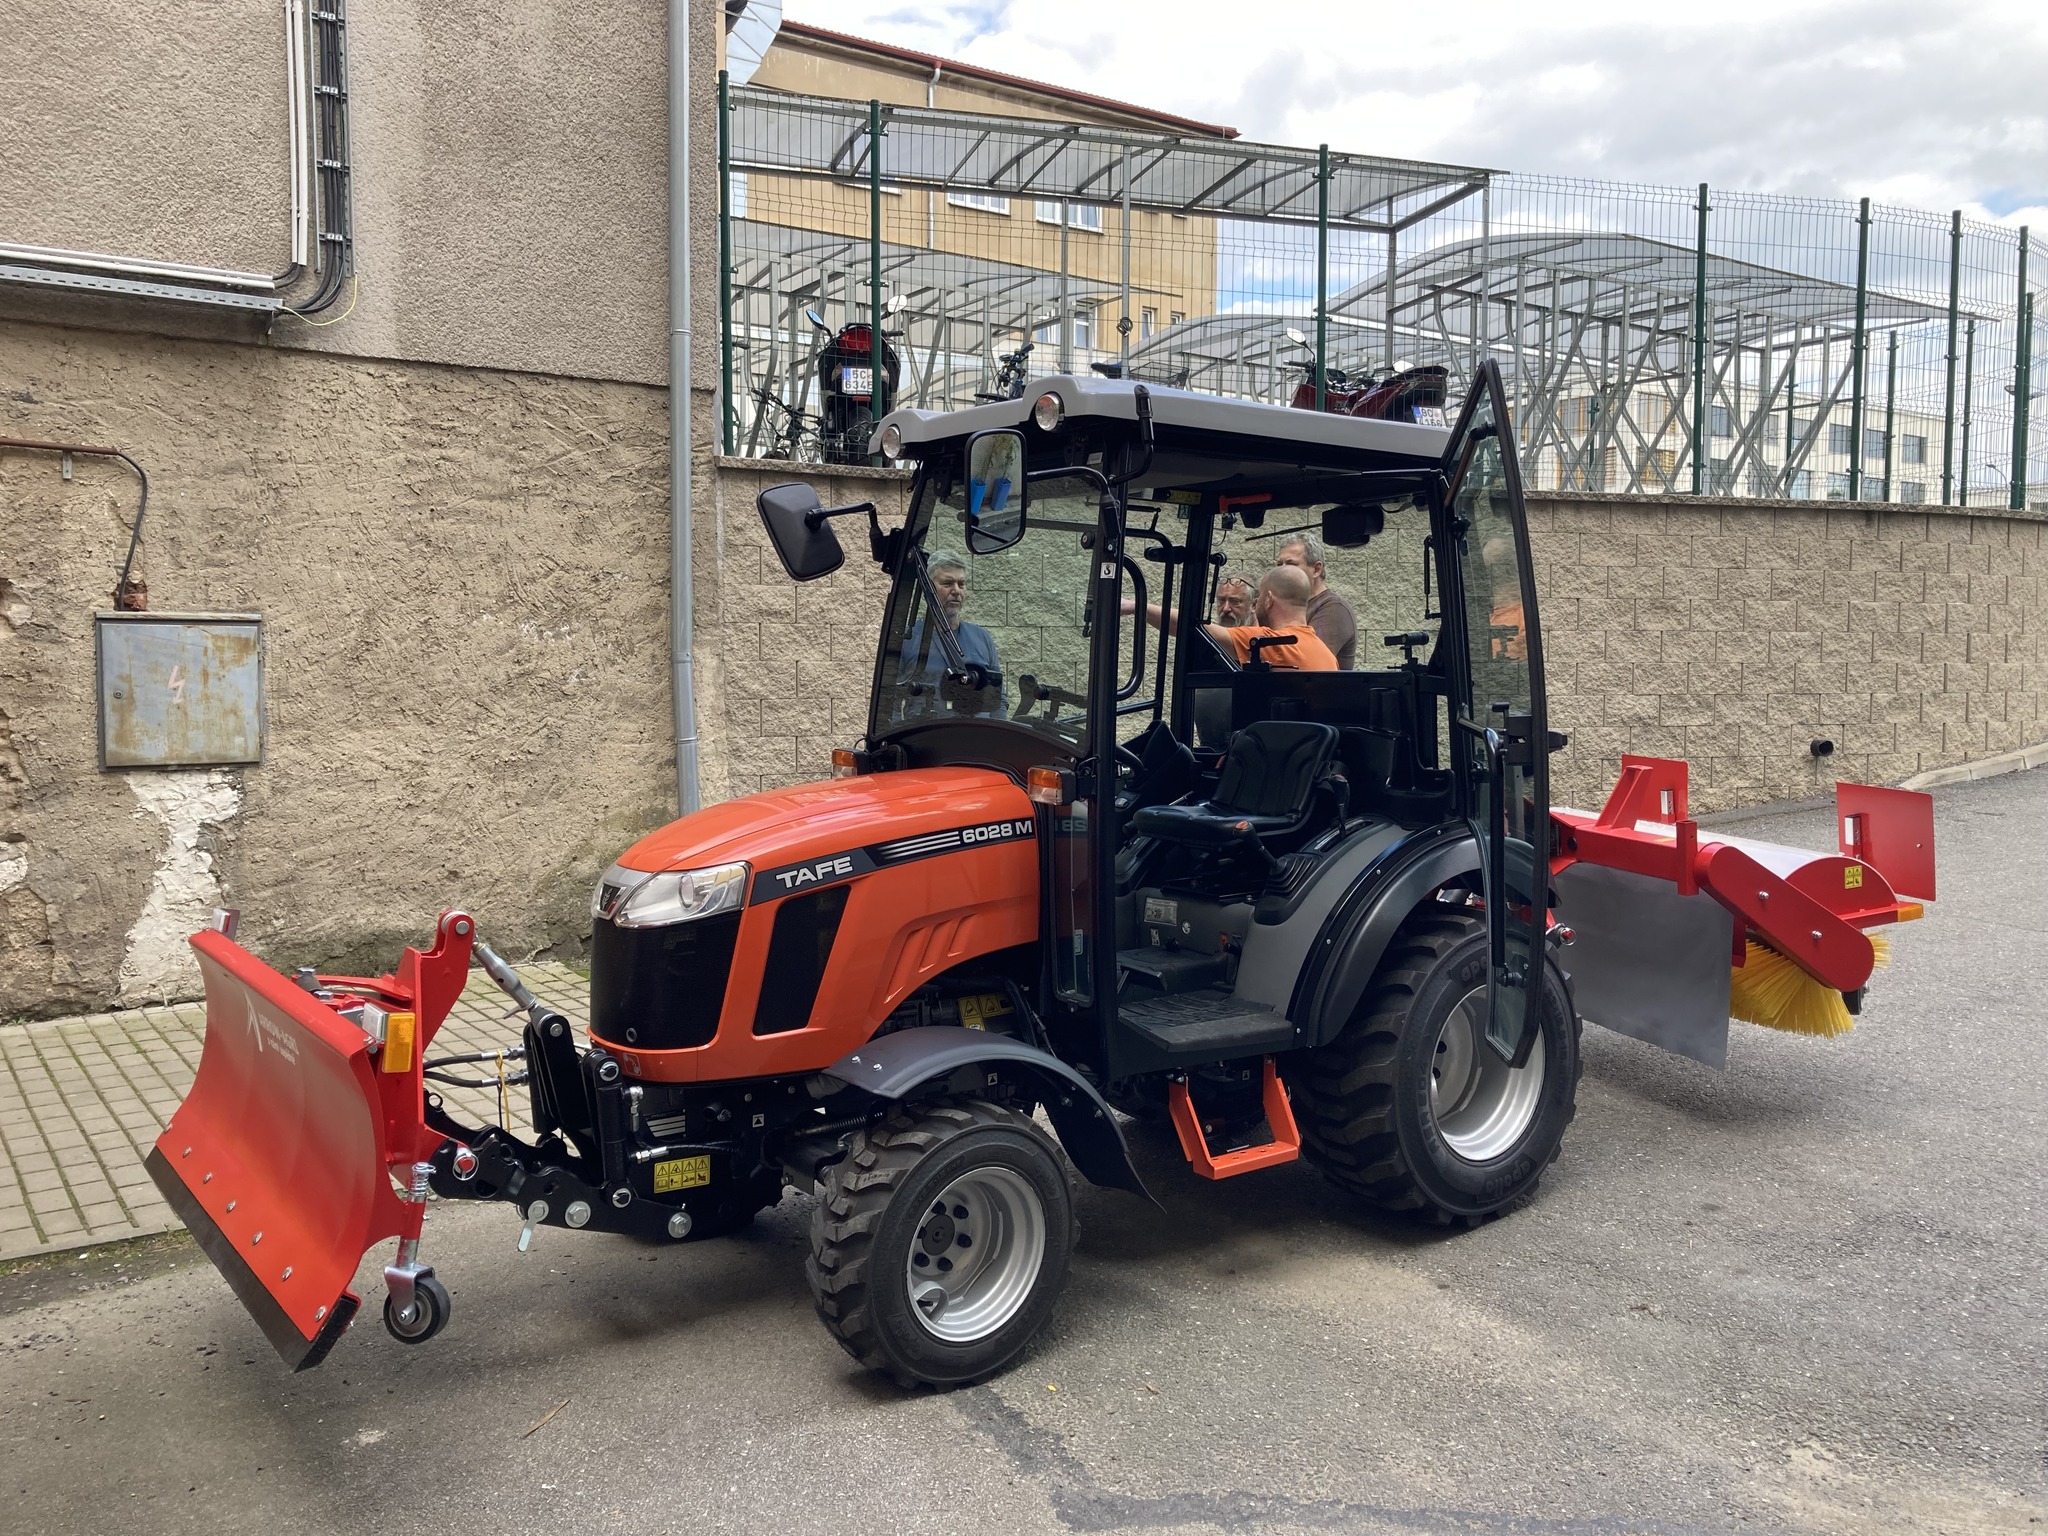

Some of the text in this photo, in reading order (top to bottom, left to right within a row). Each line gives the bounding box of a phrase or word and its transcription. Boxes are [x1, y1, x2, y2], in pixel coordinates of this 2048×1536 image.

[852, 370, 866, 380] 5C
[962, 820, 1033, 844] 6028 M
[775, 856, 854, 888] TAFE
[1461, 955, 1488, 981] apo
